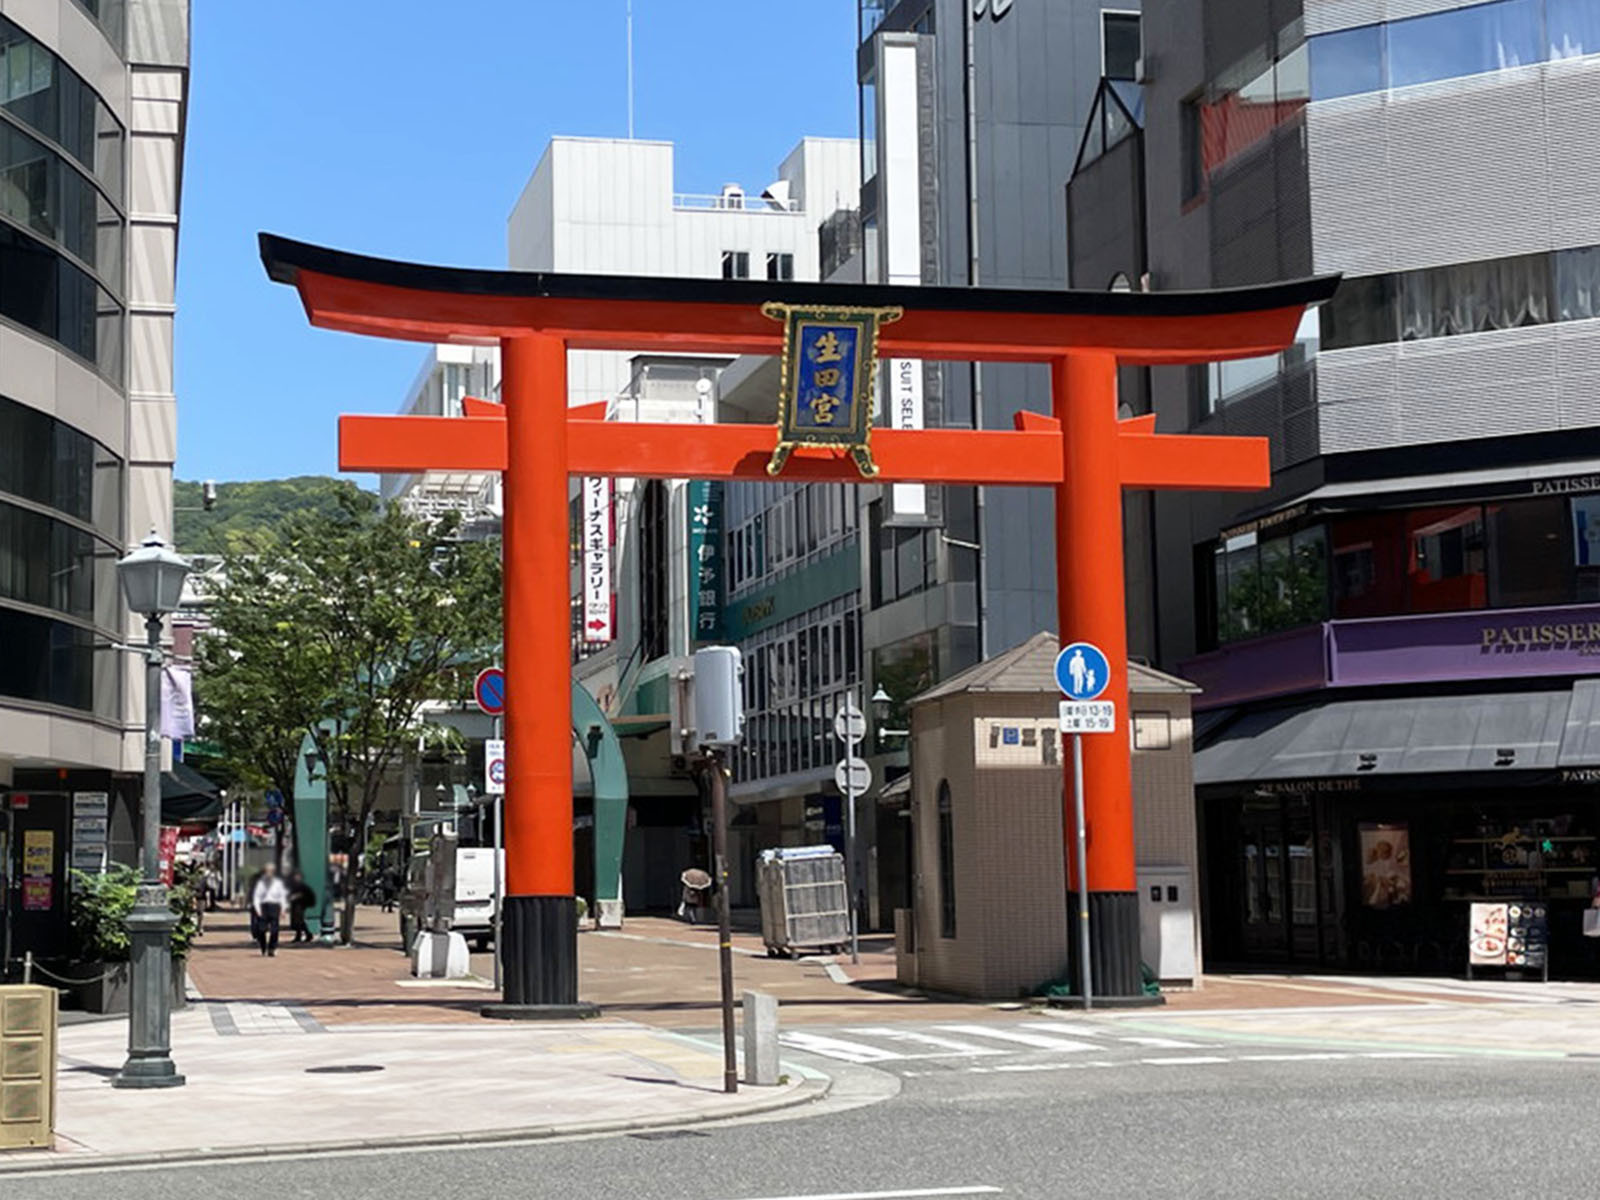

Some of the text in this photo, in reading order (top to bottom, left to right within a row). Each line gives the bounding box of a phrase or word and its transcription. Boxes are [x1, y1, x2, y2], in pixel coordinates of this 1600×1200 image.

[809, 331, 842, 424] 生田宮
[900, 361, 912, 392] SUIT
[698, 544, 715, 629] 伊予銀行
